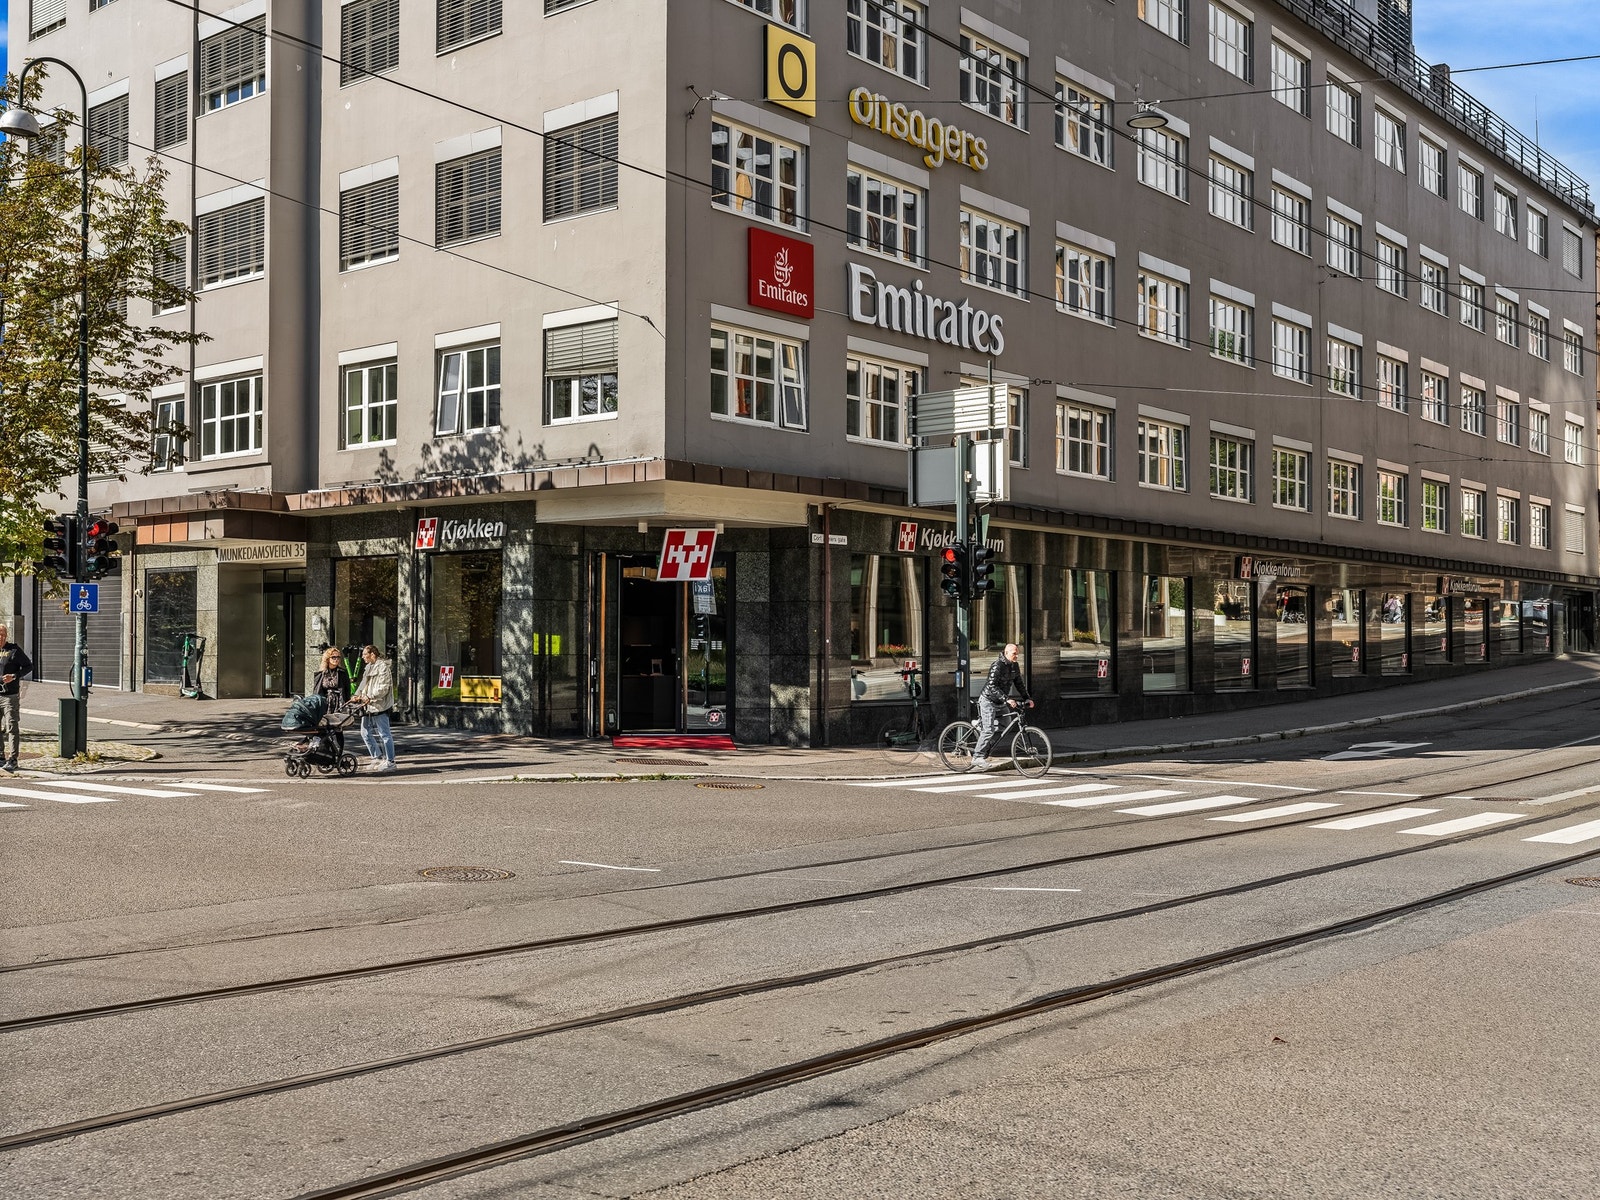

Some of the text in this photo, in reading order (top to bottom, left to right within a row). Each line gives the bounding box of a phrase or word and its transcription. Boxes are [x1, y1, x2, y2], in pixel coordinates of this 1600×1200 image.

[849, 86, 989, 172] onsagers
[758, 279, 808, 307] Emirates
[847, 262, 1005, 356] Emirates
[441, 518, 506, 544] Kjøkken
[219, 543, 305, 562] MUNKEDAMSVEIEN 35
